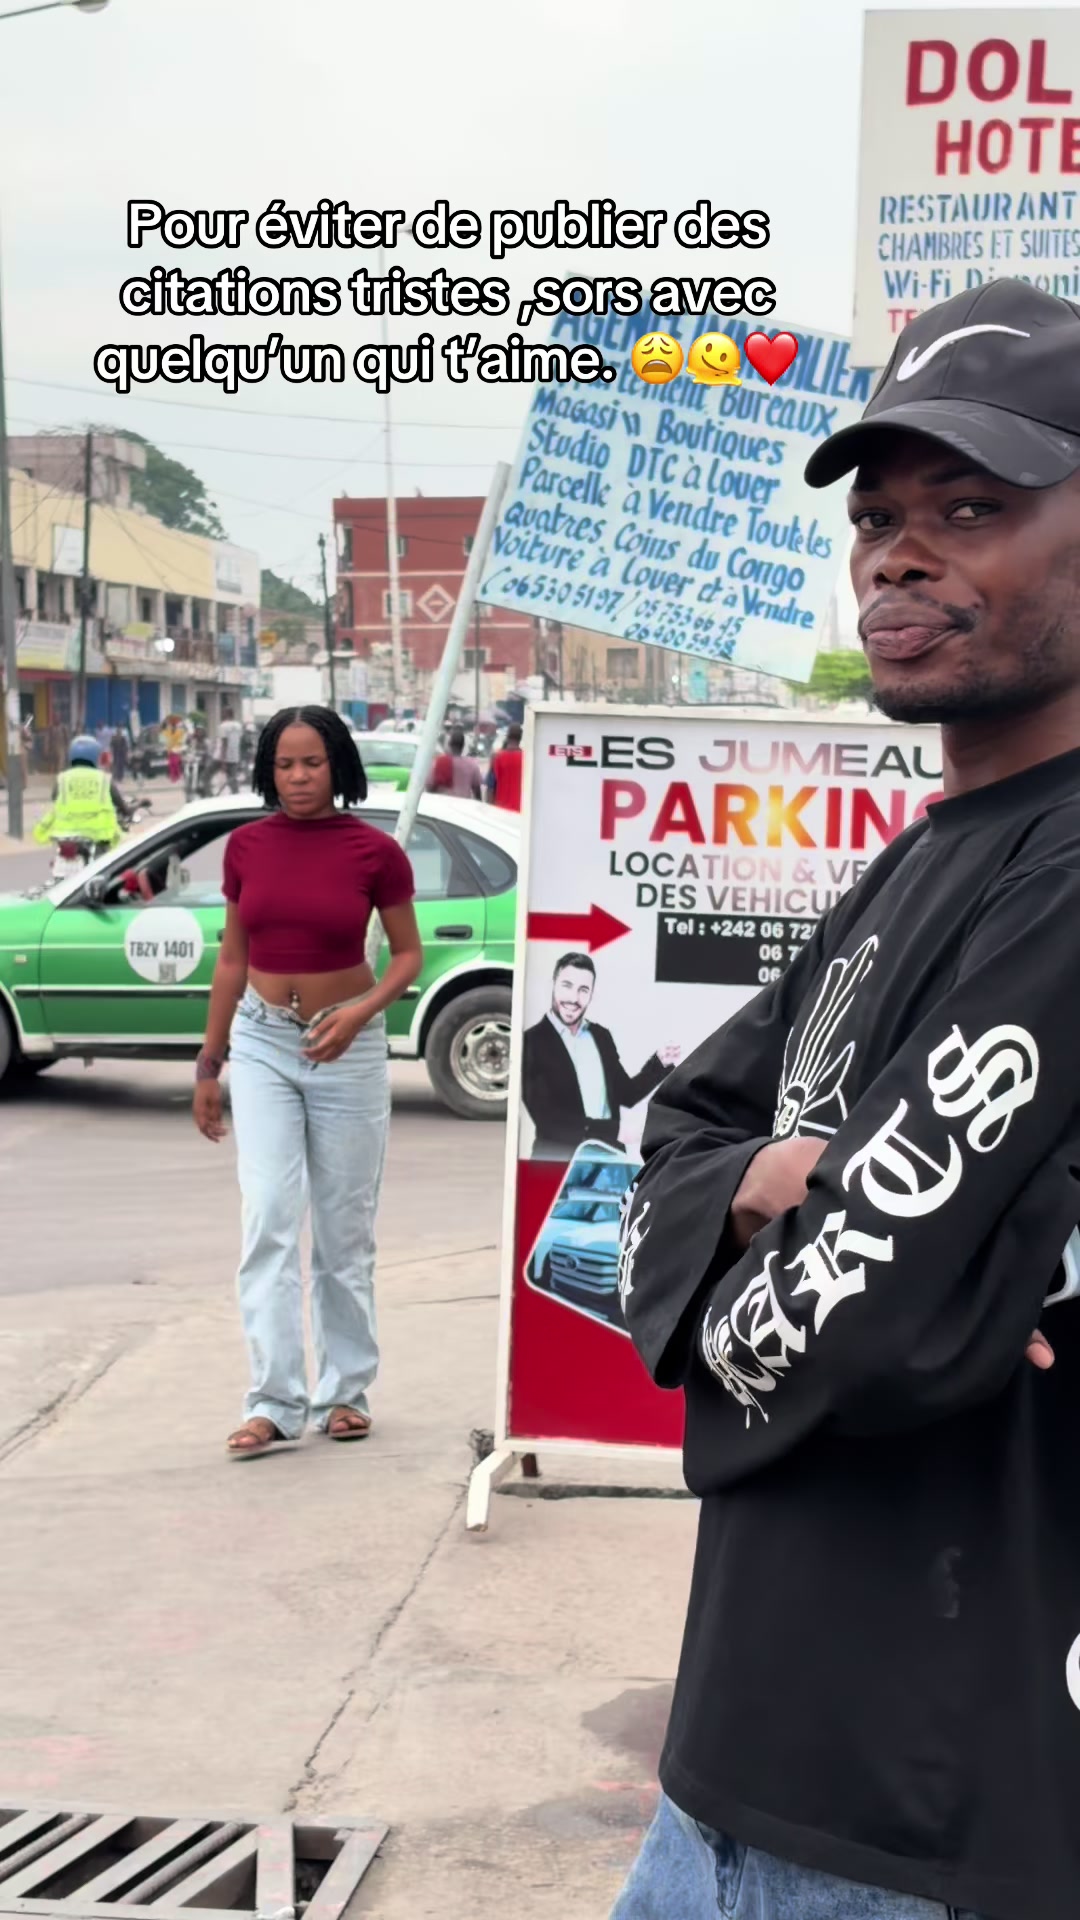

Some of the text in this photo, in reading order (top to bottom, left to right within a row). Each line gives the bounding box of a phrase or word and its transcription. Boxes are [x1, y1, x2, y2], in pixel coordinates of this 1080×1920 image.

[905, 38, 1073, 106] DOL
[879, 190, 1078, 225] RESTAURANT
[878, 231, 984, 263] CHAMBRES
[991, 229, 1014, 261] ET
[884, 267, 952, 300] Wi-Fi
[527, 418, 611, 470] Studio
[627, 443, 679, 485] DTC
[681, 454, 702, 491] à
[655, 408, 787, 466] Boutiques
[621, 481, 642, 516] à
[649, 487, 739, 538] Vendre
[504, 500, 806, 597] Quatres Coins du Congo
[493, 524, 585, 572] Voiture
[588, 545, 612, 578] à
[742, 584, 815, 630] Vendre
[566, 733, 676, 771] LES
[609, 850, 782, 883] LOCATION
[791, 857, 816, 885] &
[636, 882, 697, 910] DES
[664, 917, 694, 936] Tel
[709, 919, 756, 938] +242
[760, 921, 785, 939] 06
[789, 922, 818, 940] 72
[129, 940, 195, 959] TBZV 1401
[758, 944, 783, 962] 06
